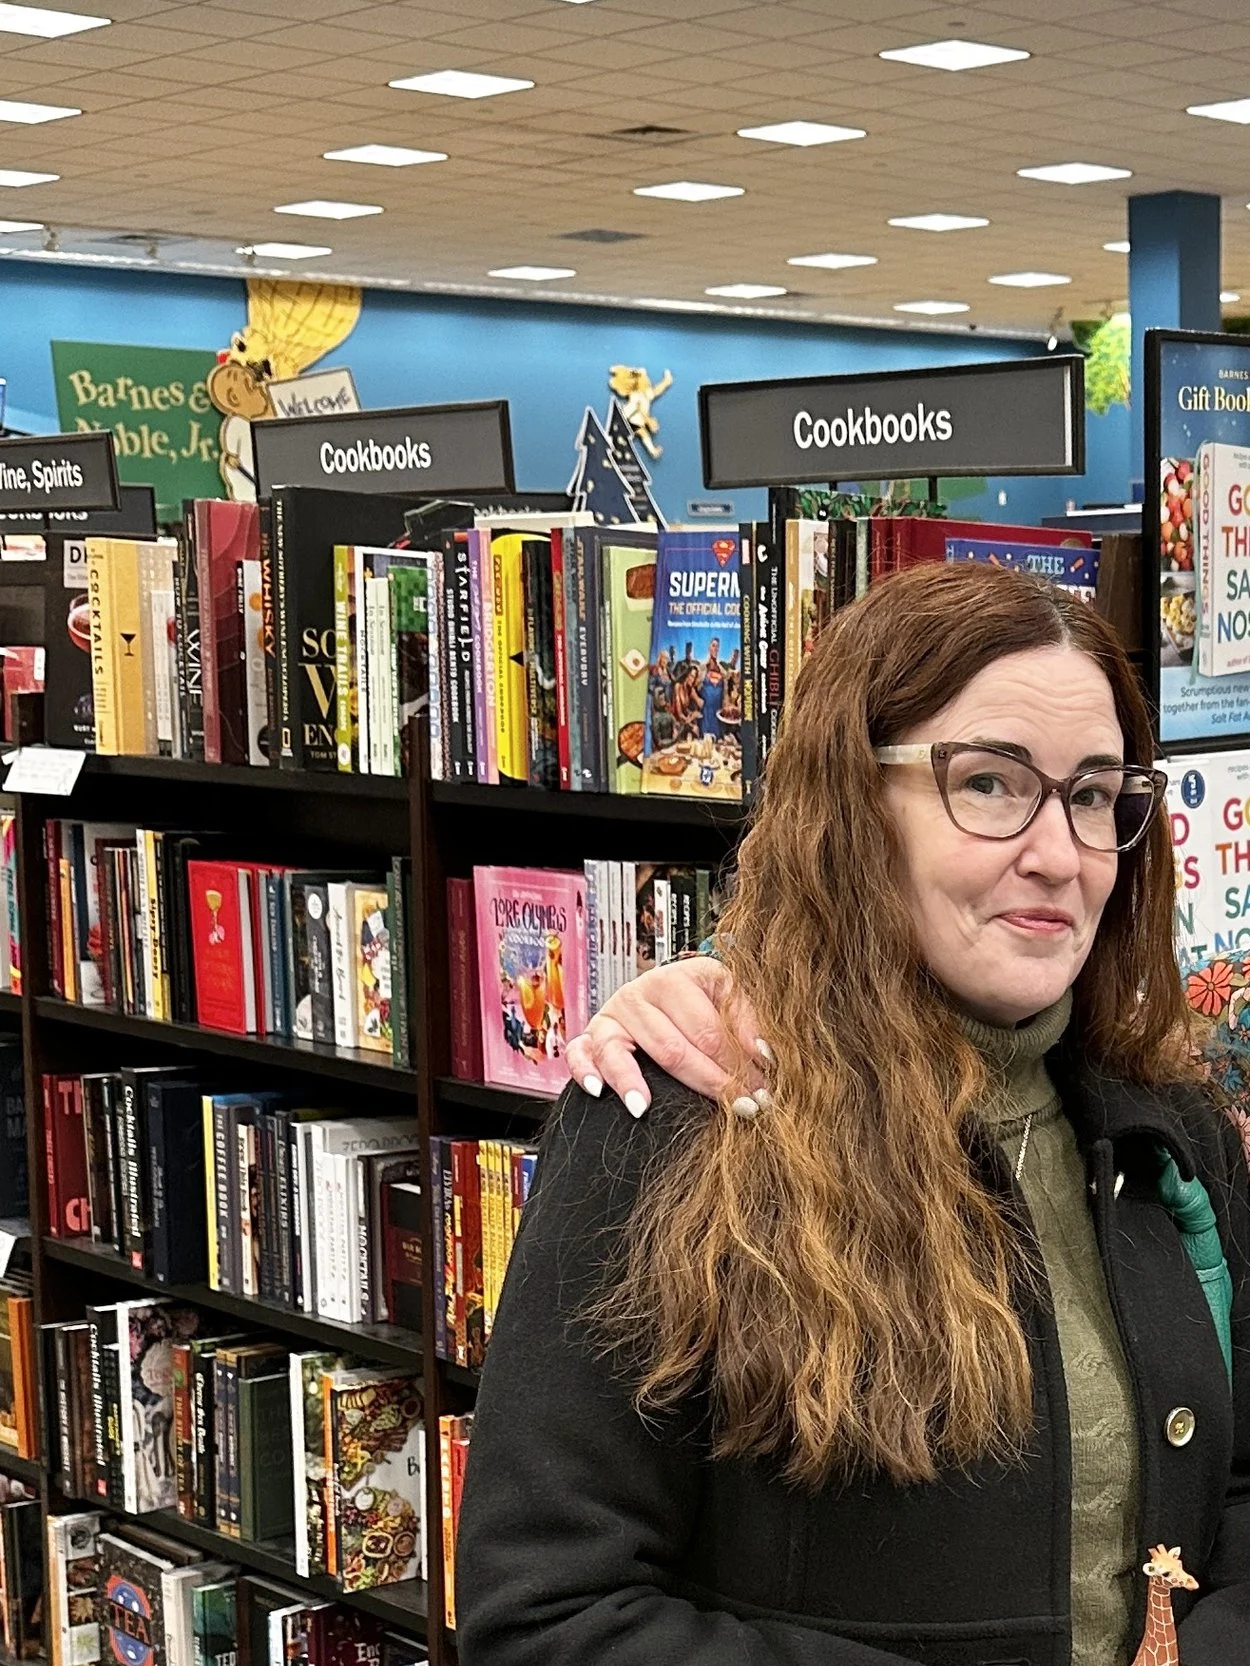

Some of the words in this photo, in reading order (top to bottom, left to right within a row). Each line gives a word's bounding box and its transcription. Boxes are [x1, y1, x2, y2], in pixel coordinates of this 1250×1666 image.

[67, 369, 185, 412] Barnes
[1218, 369, 1249, 381] BARNES
[1178, 386, 1212, 411] Gift
[182, 420, 220, 463] Jr.
[793, 403, 954, 450] Cookbooks
[32, 459, 84, 495] Spirits
[320, 436, 432, 475] Cookbooks
[770, 566, 779, 587] THE
[1026, 554, 1066, 576] THE
[90, 569, 103, 676] COCKTAILS
[261, 559, 276, 659] WHISKY
[336, 600, 346, 642] WINE
[455, 552, 474, 663] STARFIELD
[668, 602, 683, 614] THE
[685, 602, 721, 616] OFFICIAL
[742, 594, 751, 644] COOKING
[770, 588, 779, 644] UNOFFICIAL
[338, 645, 349, 697] TRAILS
[449, 650, 457, 678] BENTO
[484, 601, 496, 707] BRIDGERTON
[580, 626, 588, 687] EVERYDAY
[744, 645, 752, 675] WITH
[767, 649, 780, 707] GHIBLI
[1180, 685, 1232, 698] Scrumptious
[1233, 685, 1249, 695] new
[450, 680, 459, 723] COOKBOOK
[1163, 700, 1199, 714] together
[1200, 699, 1220, 710] from
[1221, 699, 1235, 709] the
[1211, 713, 1227, 724] Salt
[1228, 712, 1242, 723] Fat
[492, 897, 520, 928] LORE
[522, 901, 567, 938] OLYMPUS
[124, 1085, 137, 1157] Cocktails
[216, 1131, 227, 1180] COFFEE
[128, 1161, 141, 1238] Illustrated
[218, 1184, 228, 1218] BOOK
[90, 1323, 102, 1389] Cocktails
[93, 1394, 106, 1466] Illustrated
[112, 1603, 150, 1644] TEA
